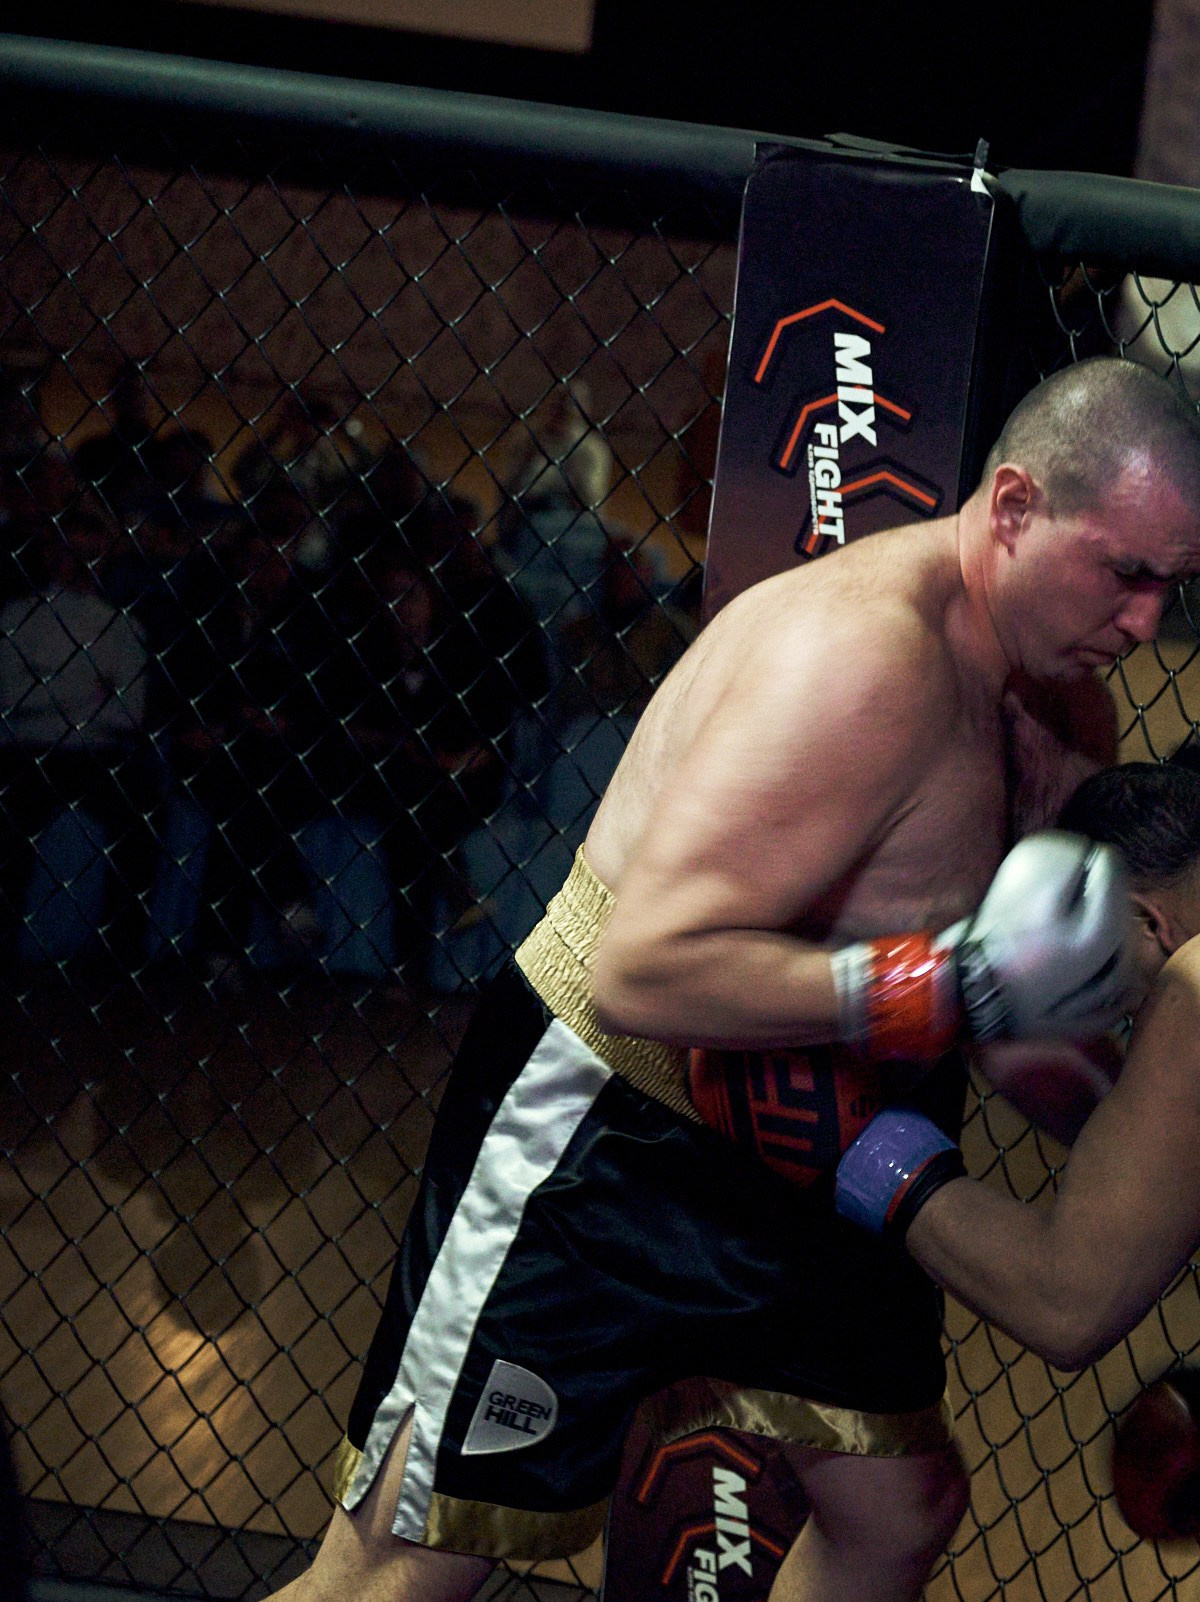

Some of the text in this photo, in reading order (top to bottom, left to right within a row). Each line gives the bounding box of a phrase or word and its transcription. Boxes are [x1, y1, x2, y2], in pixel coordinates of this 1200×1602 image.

[833, 332, 877, 447] MIX
[814, 423, 845, 544] FIGHT
[484, 1405, 537, 1435] HILL
[489, 1391, 552, 1420] GREEN
[712, 1466, 753, 1578] MIX
